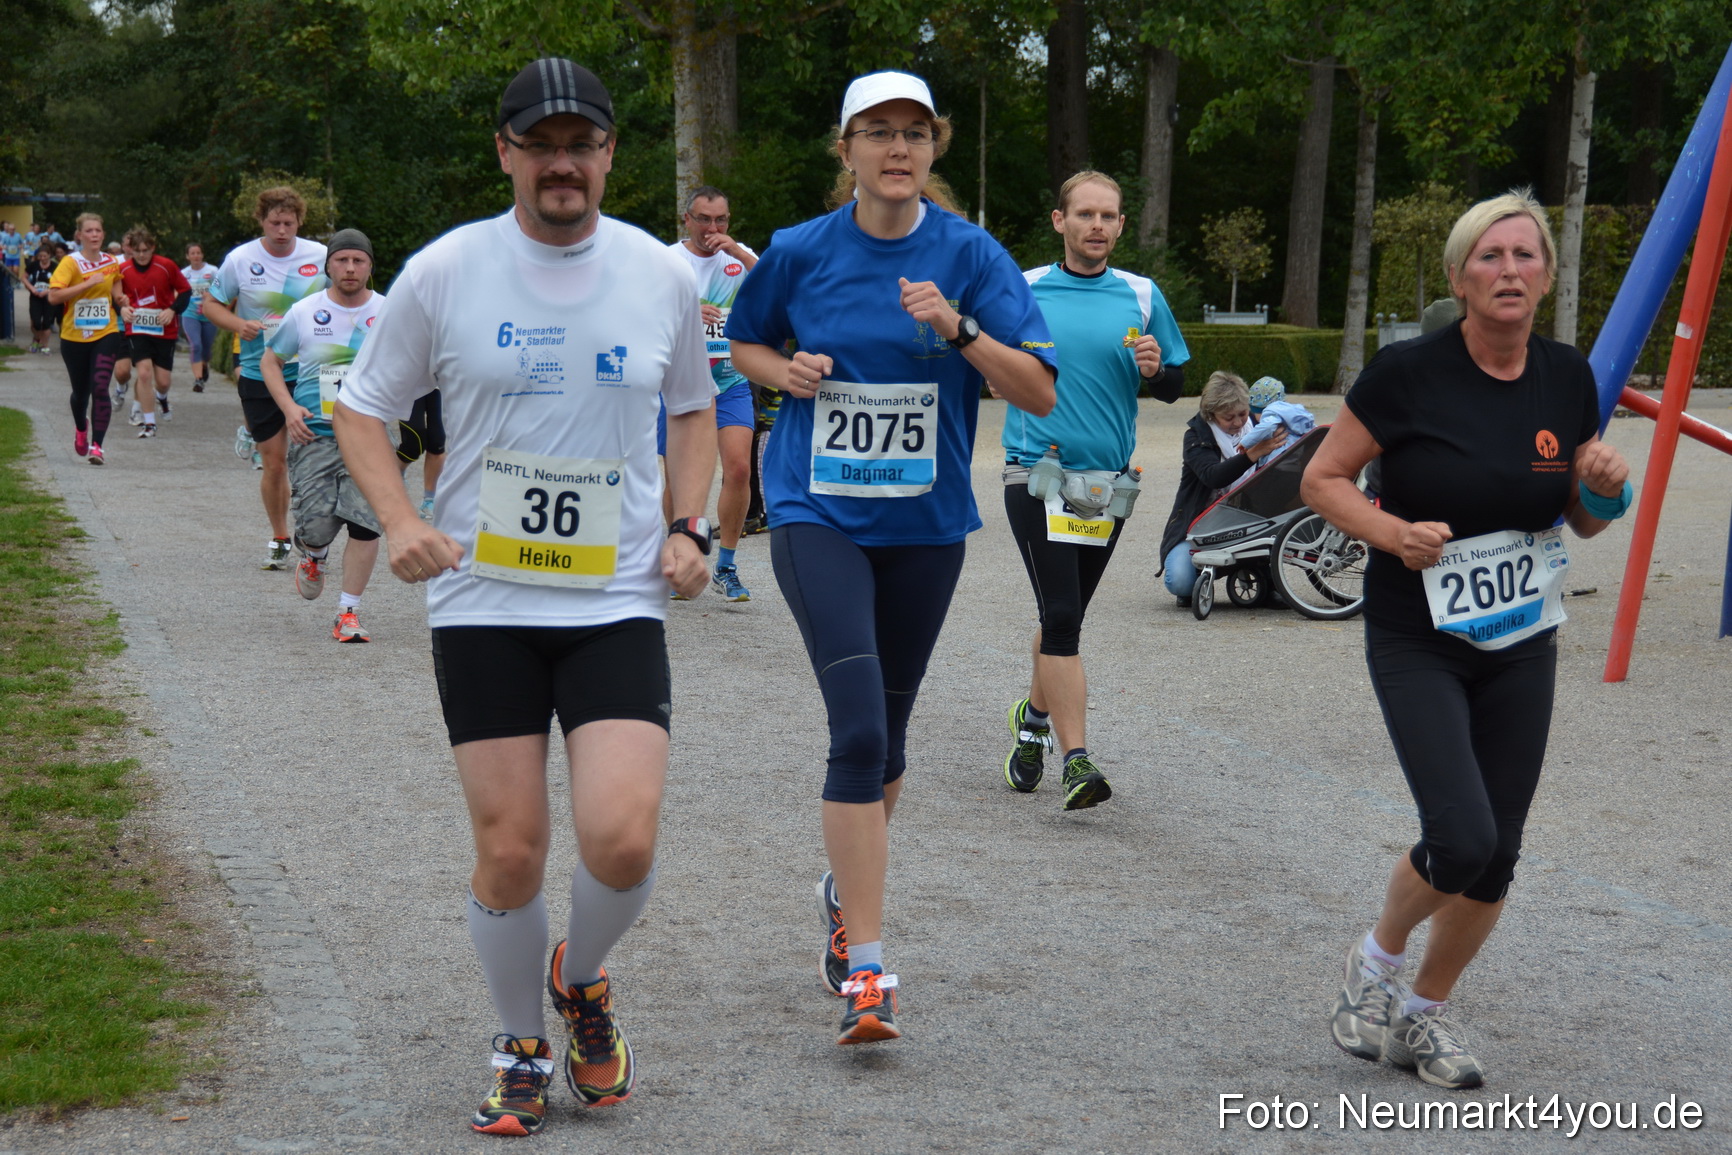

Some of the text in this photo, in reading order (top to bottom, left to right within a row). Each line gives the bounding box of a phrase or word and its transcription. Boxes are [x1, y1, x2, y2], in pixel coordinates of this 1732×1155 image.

[78, 305, 107, 317] 2735
[497, 322, 521, 348] 6.
[515, 326, 566, 336] Neumarkter
[526, 336, 565, 346] Stadtlauf
[598, 371, 622, 381] DKMS
[818, 391, 916, 406] PARTL Neumarkt
[825, 409, 925, 453] 2075
[486, 459, 601, 484] PARTL Neumarkt
[841, 463, 904, 485] Dagmar
[521, 487, 581, 537] 36
[1067, 521, 1100, 534] Norbert
[518, 547, 572, 569] Heiko
[1426, 539, 1523, 570] ARTL Neumarkt
[1440, 554, 1539, 616] 2602
[1468, 612, 1525, 640] Angelika
